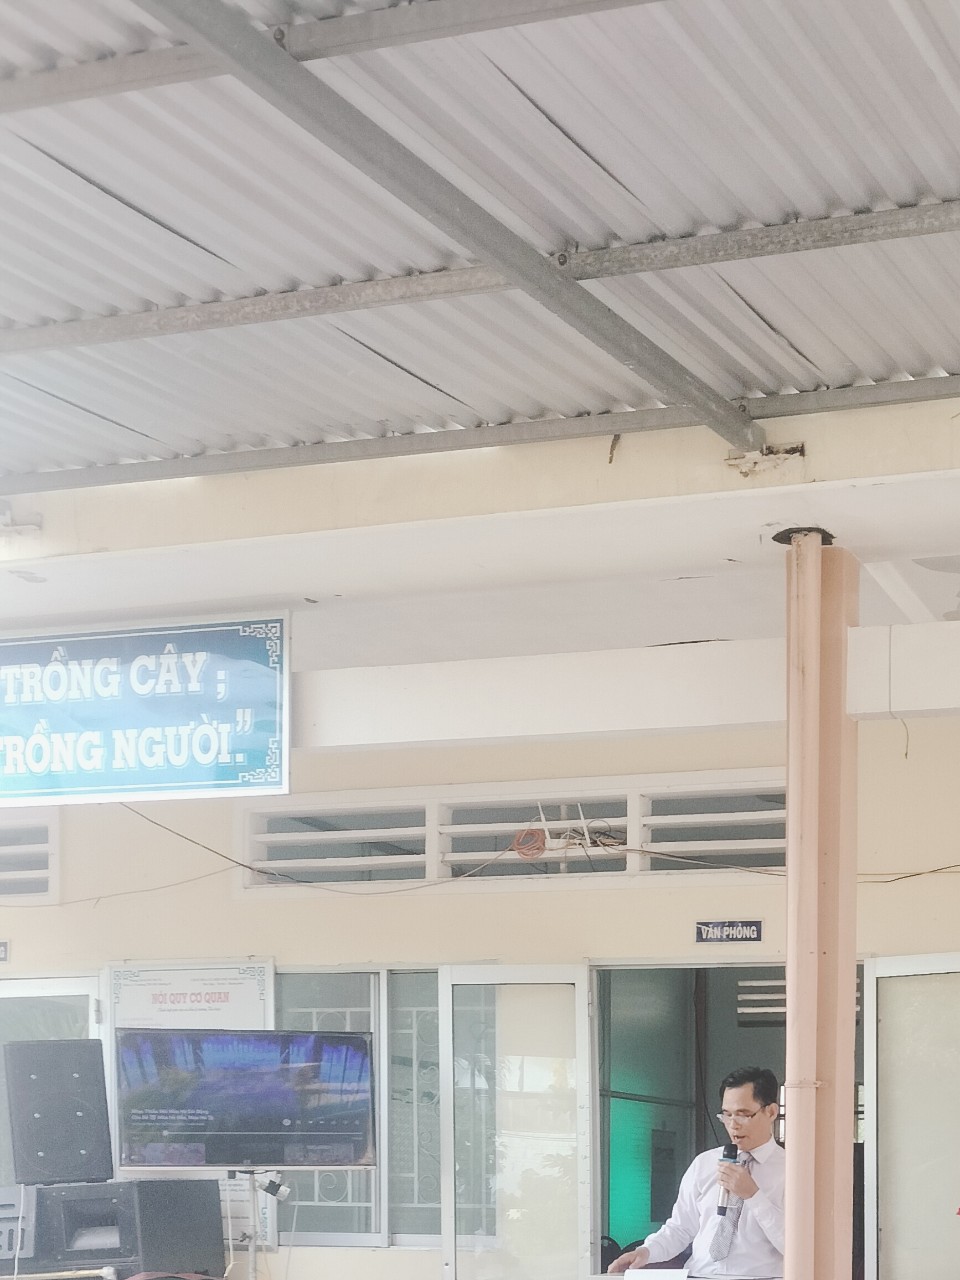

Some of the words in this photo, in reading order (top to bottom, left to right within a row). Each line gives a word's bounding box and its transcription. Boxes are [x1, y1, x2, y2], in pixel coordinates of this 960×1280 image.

[1, 646, 121, 704] TRỒNG
[130, 643, 208, 696] CÂY
[0, 719, 104, 775] RỒNG
